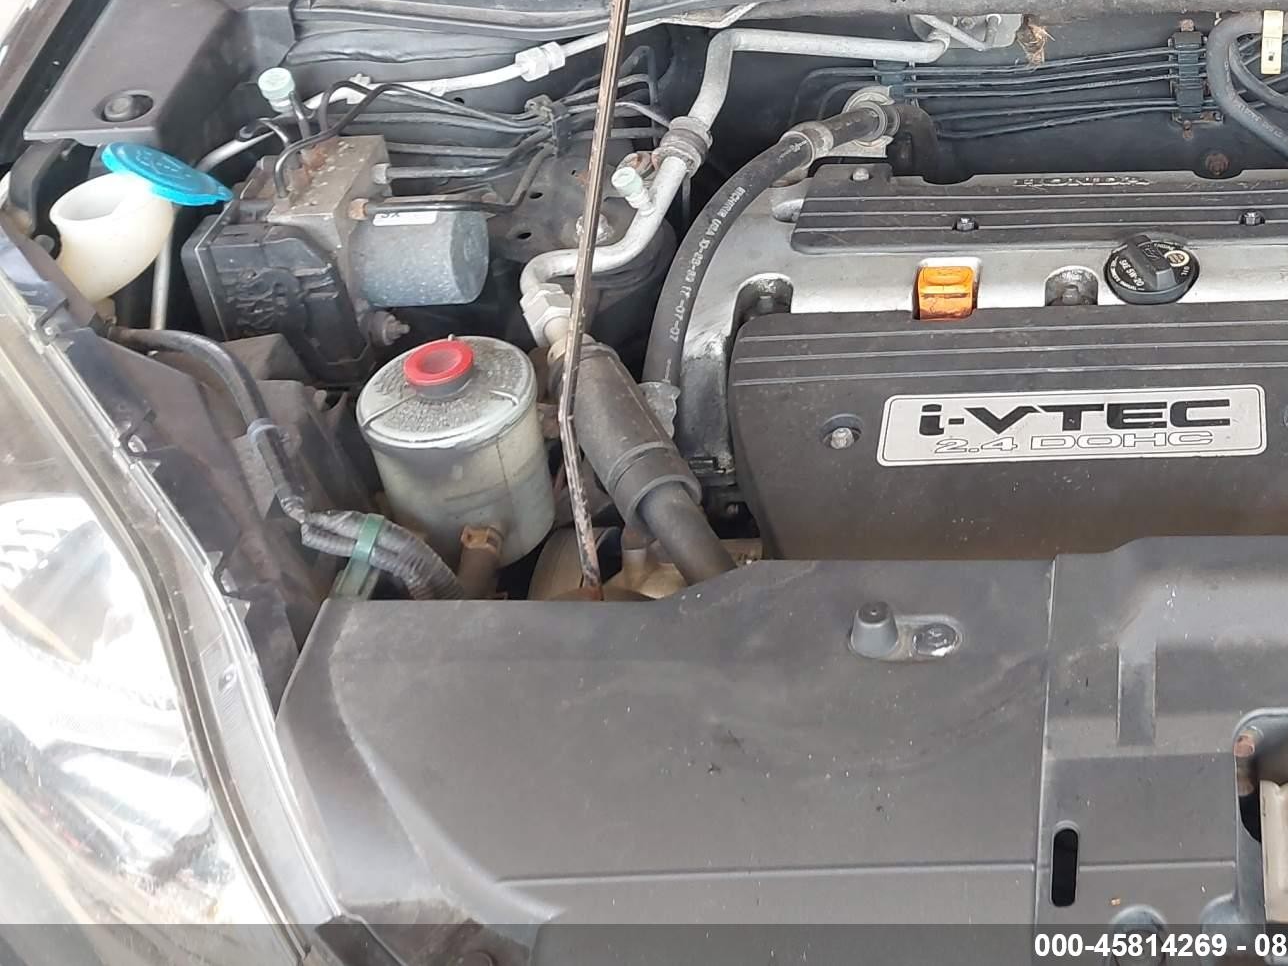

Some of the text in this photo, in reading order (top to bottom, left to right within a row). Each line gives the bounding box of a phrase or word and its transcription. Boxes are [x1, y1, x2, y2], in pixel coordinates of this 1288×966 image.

[1012, 176, 1152, 188] HONDA
[919, 399, 1230, 435] i-VTEC
[934, 431, 1213, 454] 2.4 DOHC
